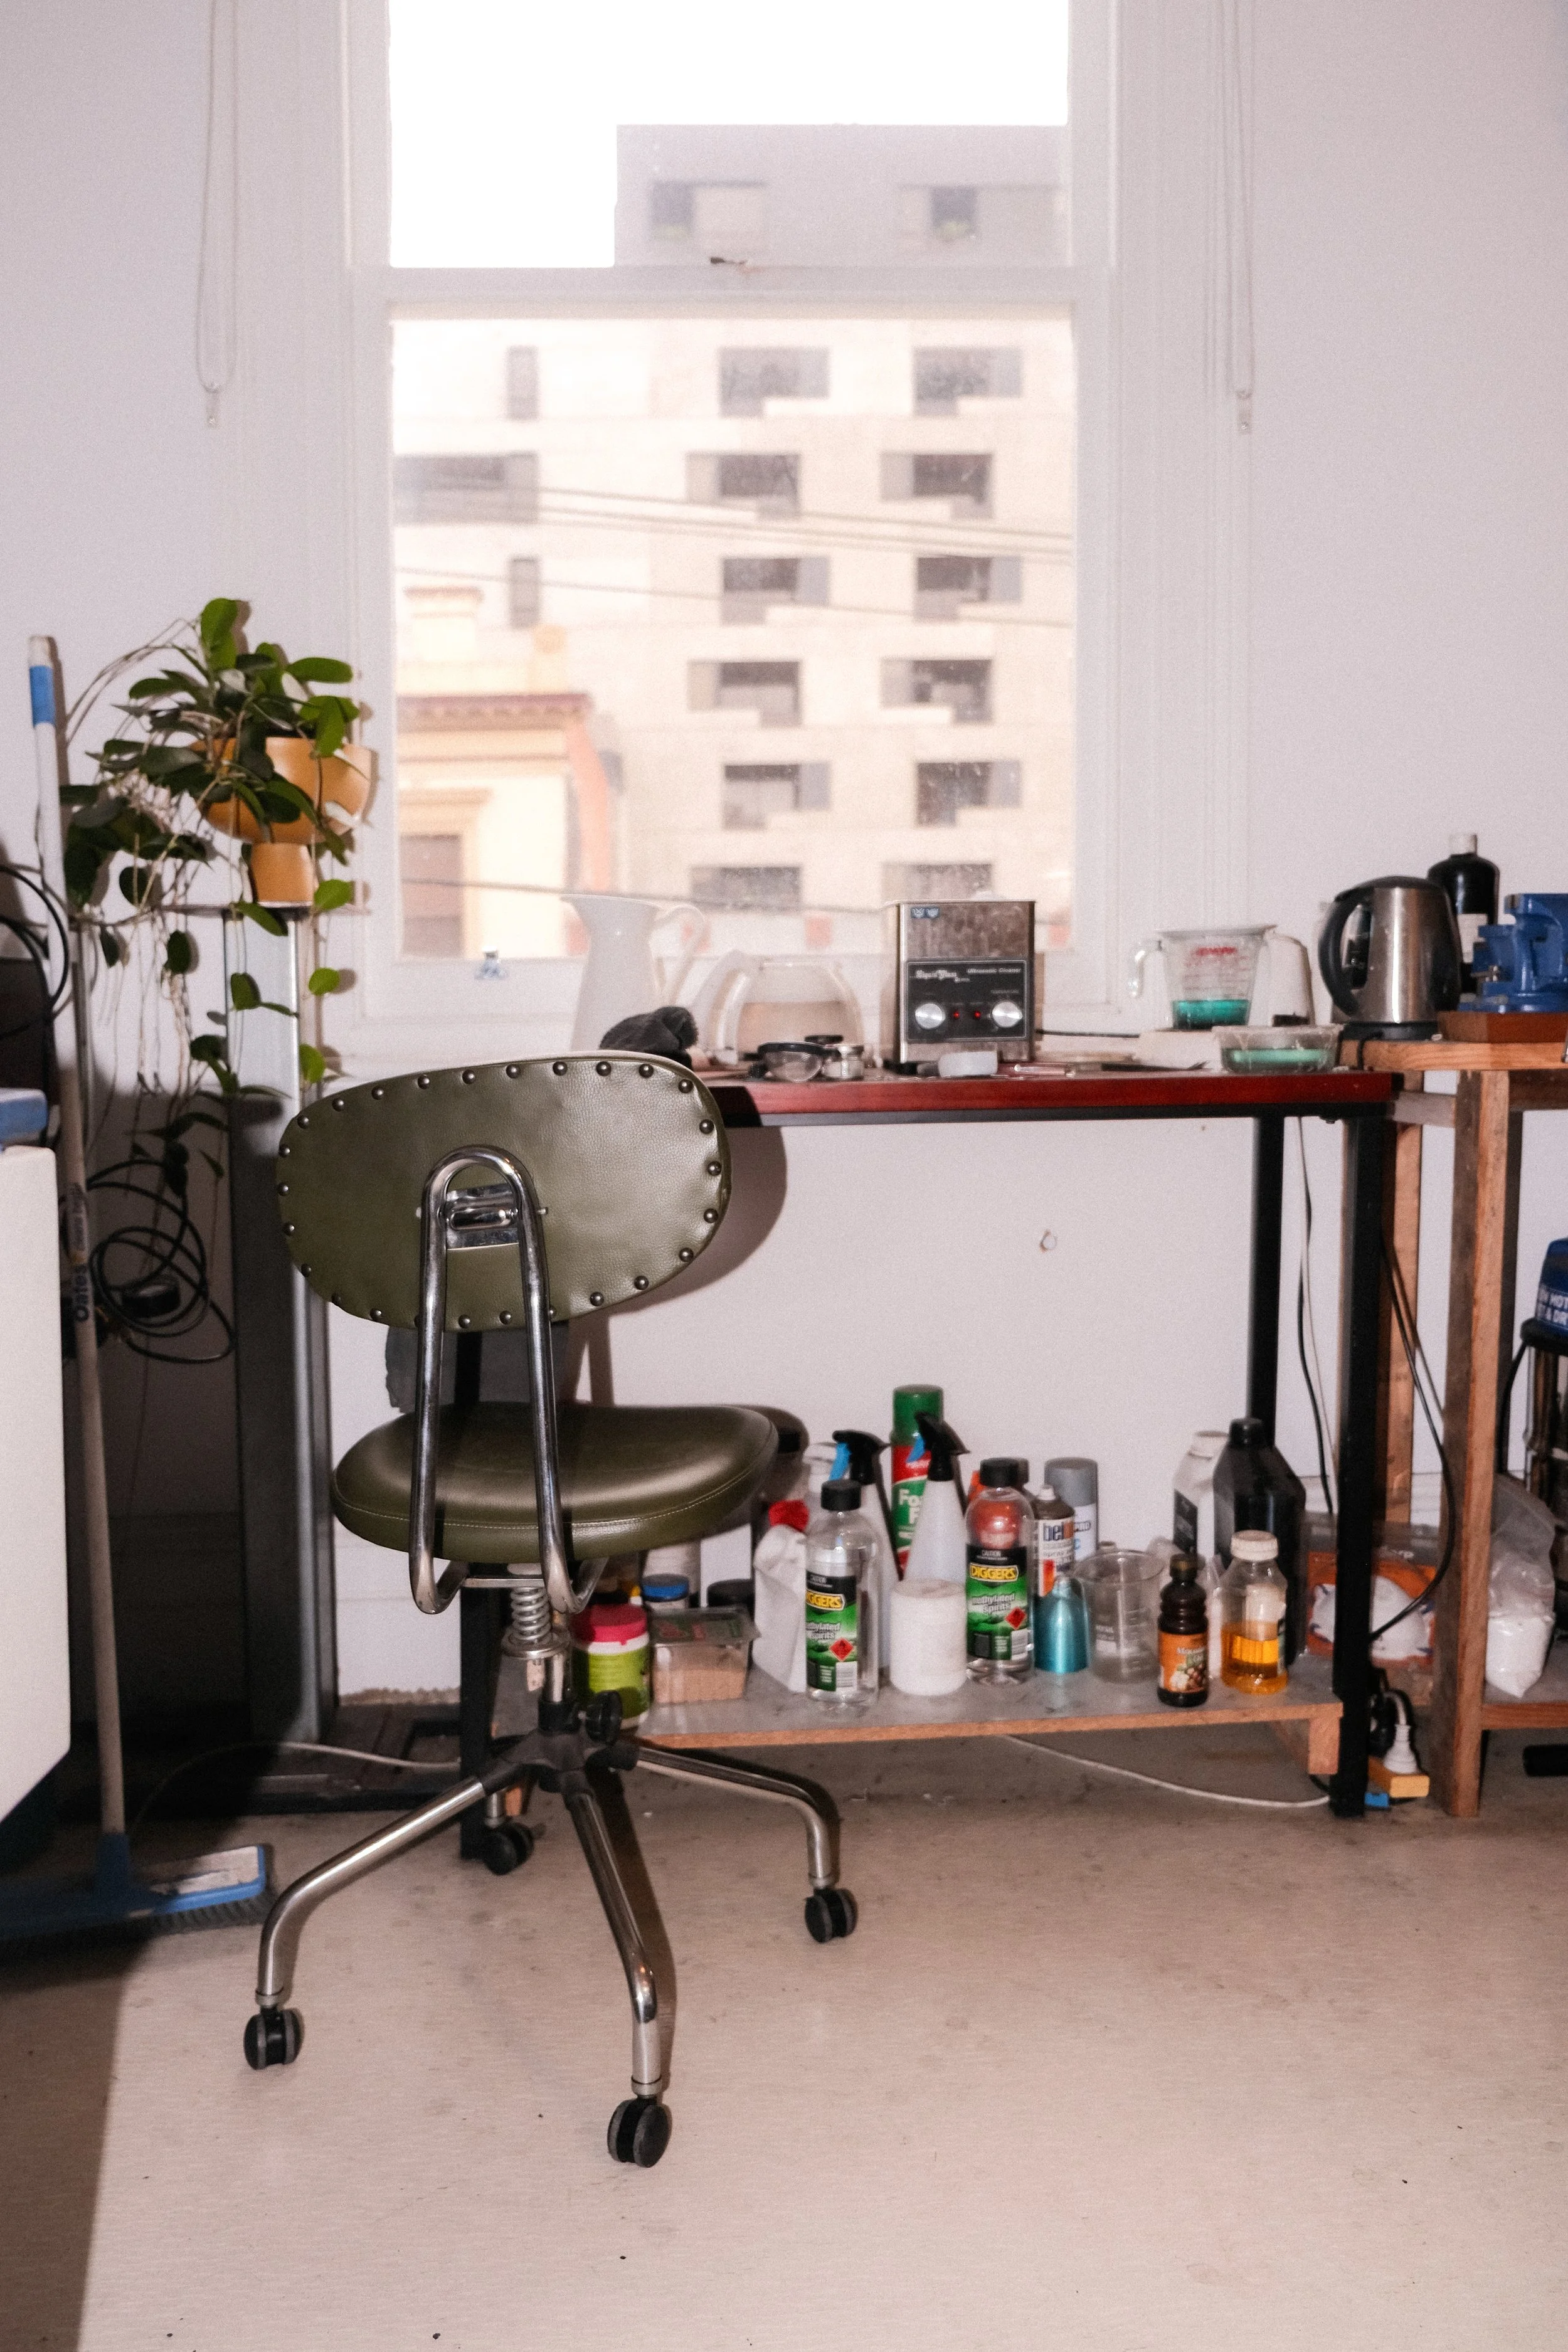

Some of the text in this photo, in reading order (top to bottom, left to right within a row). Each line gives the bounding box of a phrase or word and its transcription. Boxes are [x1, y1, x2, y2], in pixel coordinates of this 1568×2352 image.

[971, 1565, 1017, 1580] DIGGERS
[806, 1591, 842, 1609] IGGERS
[972, 1593, 1015, 1606] methylated
[983, 1602, 1012, 1615] spirits
